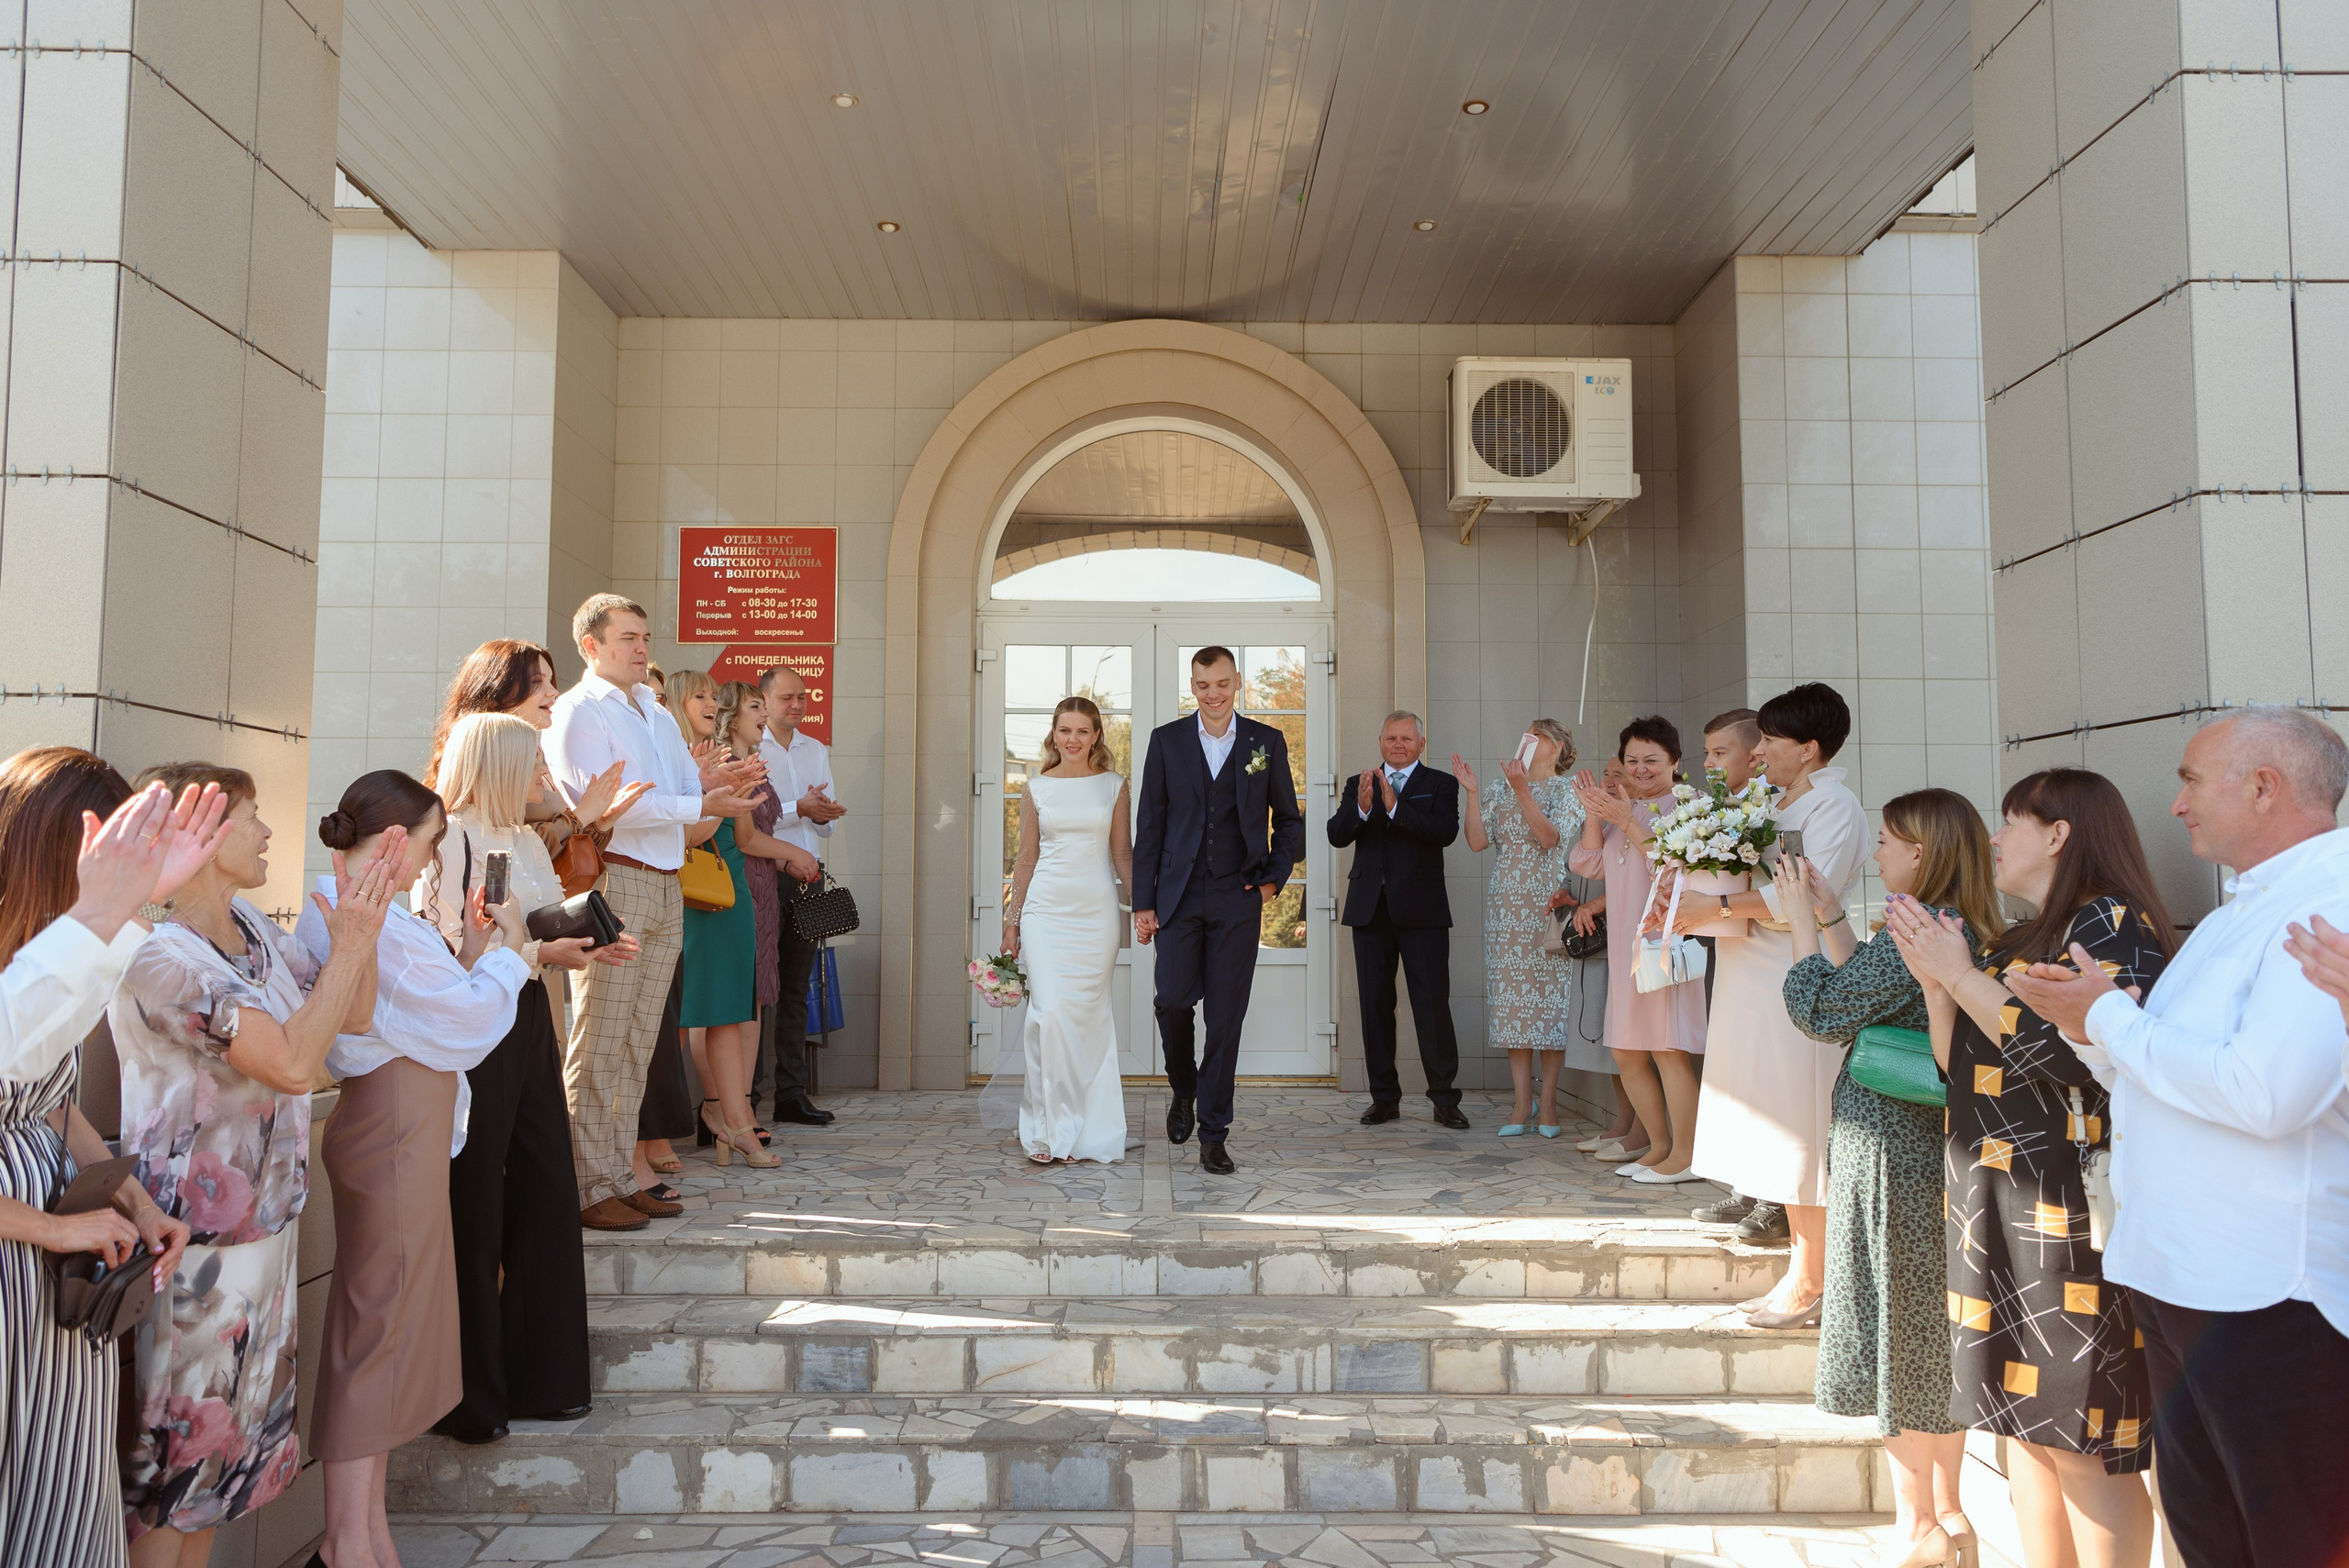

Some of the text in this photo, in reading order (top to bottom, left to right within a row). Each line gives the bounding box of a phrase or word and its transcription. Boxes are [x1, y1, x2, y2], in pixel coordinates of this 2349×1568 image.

[1596, 376, 1621, 385] JAX
[723, 535, 794, 546] ОТДЕЛ ЗАГС
[703, 546, 812, 557] АДМИНИСТРАЦИИ
[693, 555, 822, 568] СОВЕТСКОГО РАЙОНА
[714, 569, 801, 580] г. ВОЛГОГРАДА
[728, 586, 787, 595] Режим работы:
[696, 599, 708, 607] ПН
[715, 599, 727, 607] СБ
[748, 598, 776, 607] 08-30
[790, 598, 818, 607] 17-30
[696, 612, 732, 620] Перерыв
[749, 610, 776, 619] 13-00
[790, 610, 818, 619] 14-00
[696, 628, 739, 636] Выходной:
[735, 655, 825, 666] ПОНЕДЕЛЬНИКА
